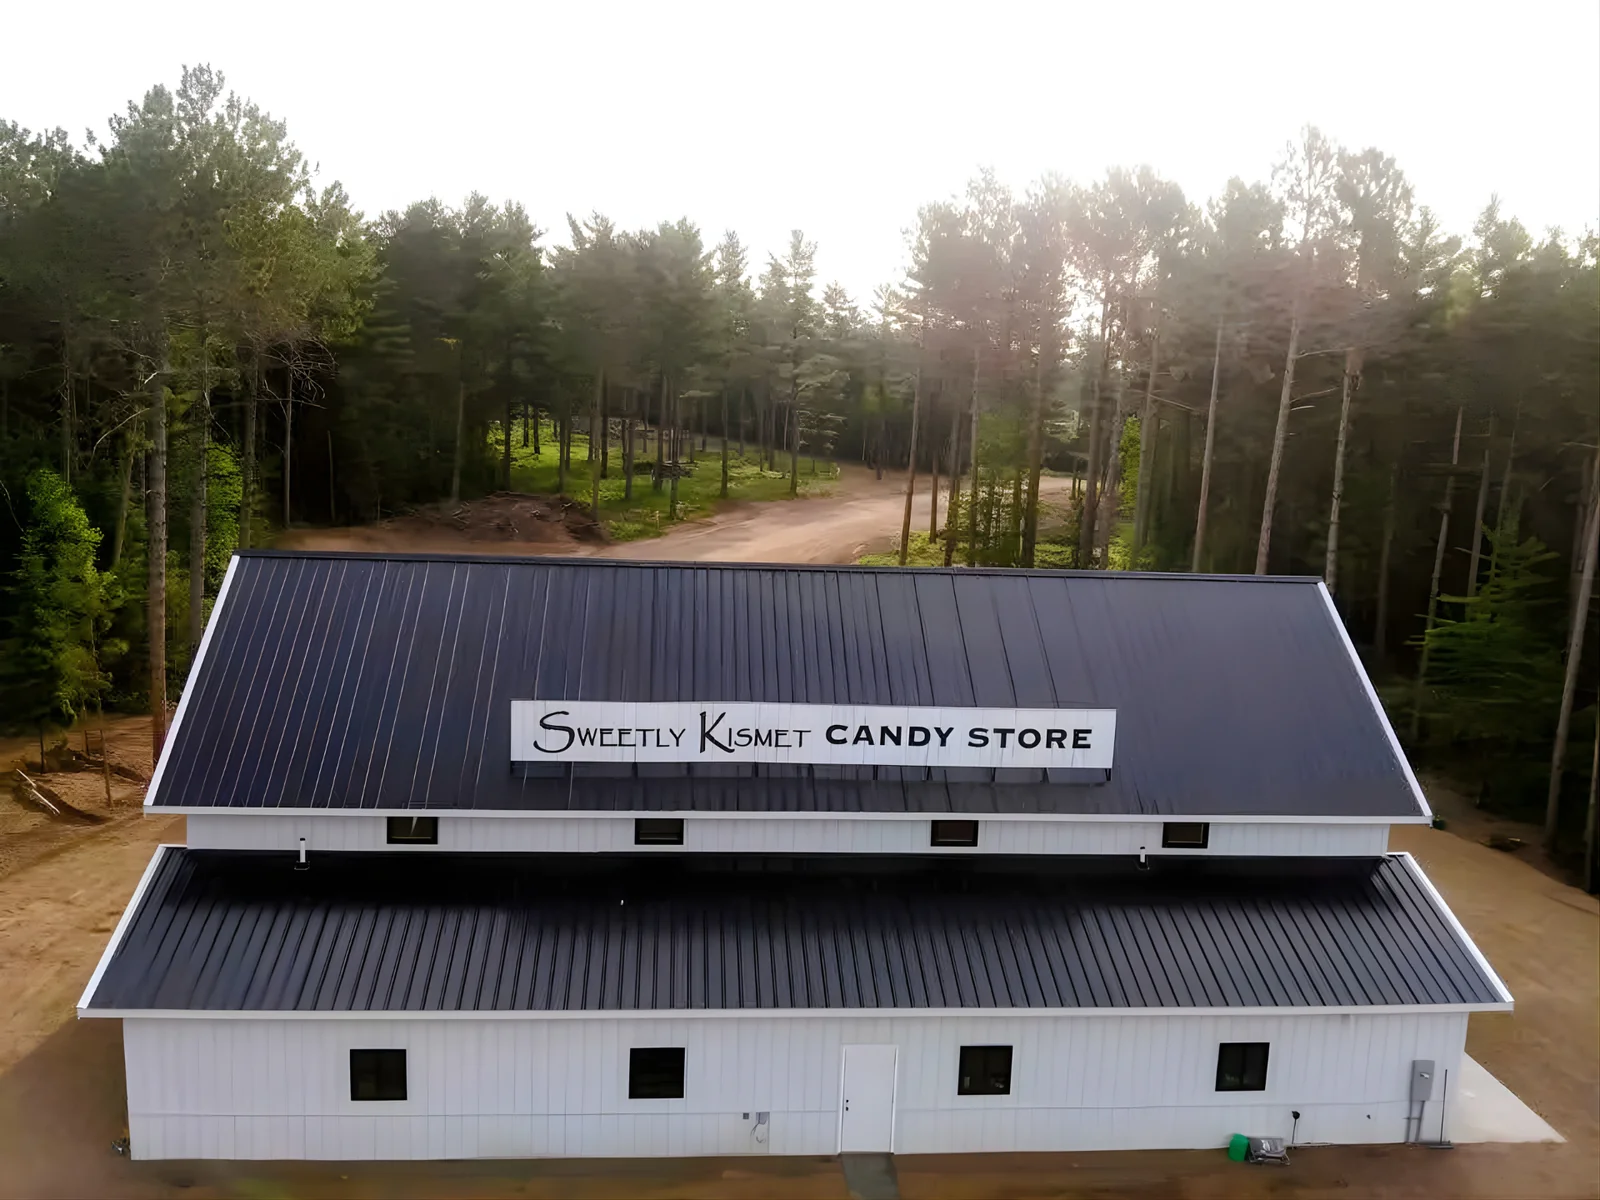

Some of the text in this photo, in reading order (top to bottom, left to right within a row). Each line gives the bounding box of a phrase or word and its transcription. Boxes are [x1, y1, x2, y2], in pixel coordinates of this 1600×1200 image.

[533, 711, 1093, 754] SWEETLY KISMET CANDY STORE
